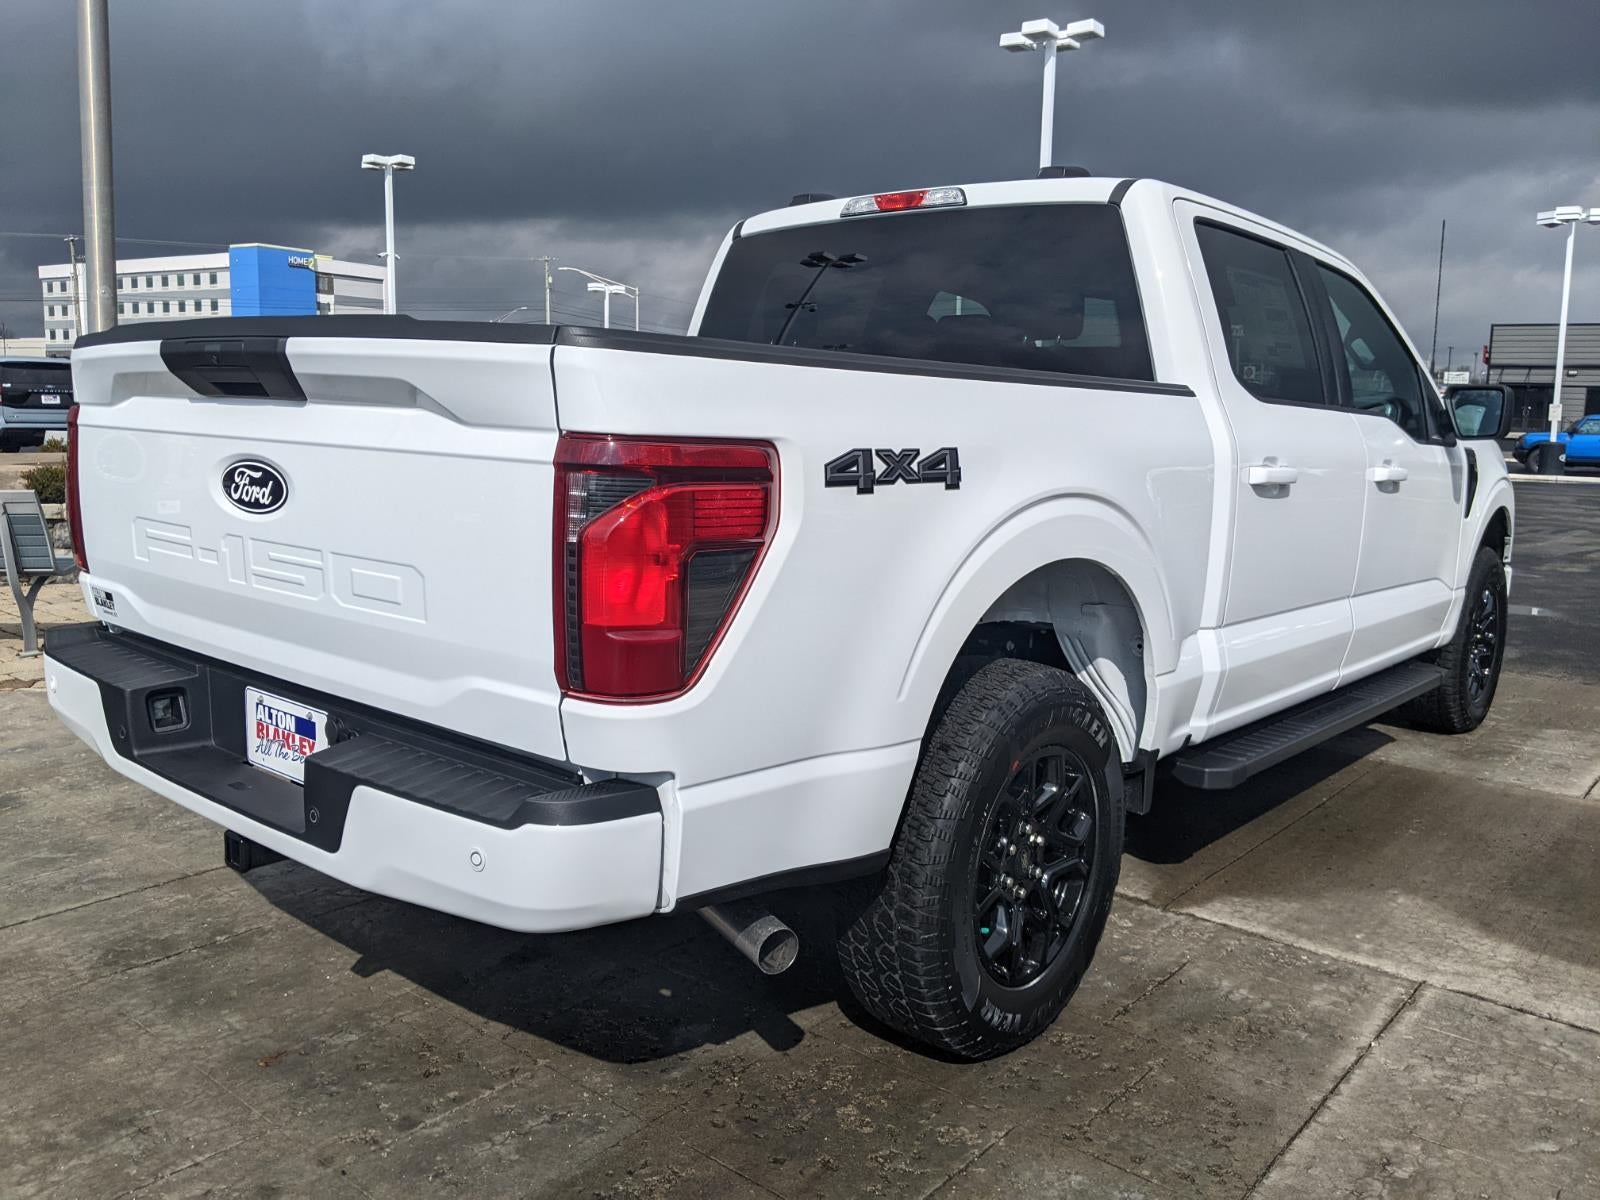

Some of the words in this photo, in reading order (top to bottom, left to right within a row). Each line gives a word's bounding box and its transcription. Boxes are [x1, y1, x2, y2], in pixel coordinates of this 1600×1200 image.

[230, 467, 273, 505] Ford
[132, 516, 427, 624] F-150
[255, 703, 297, 733] ALTON
[255, 738, 274, 758] All
[271, 739, 290, 761] The
[256, 721, 317, 757] BLAKLEY
